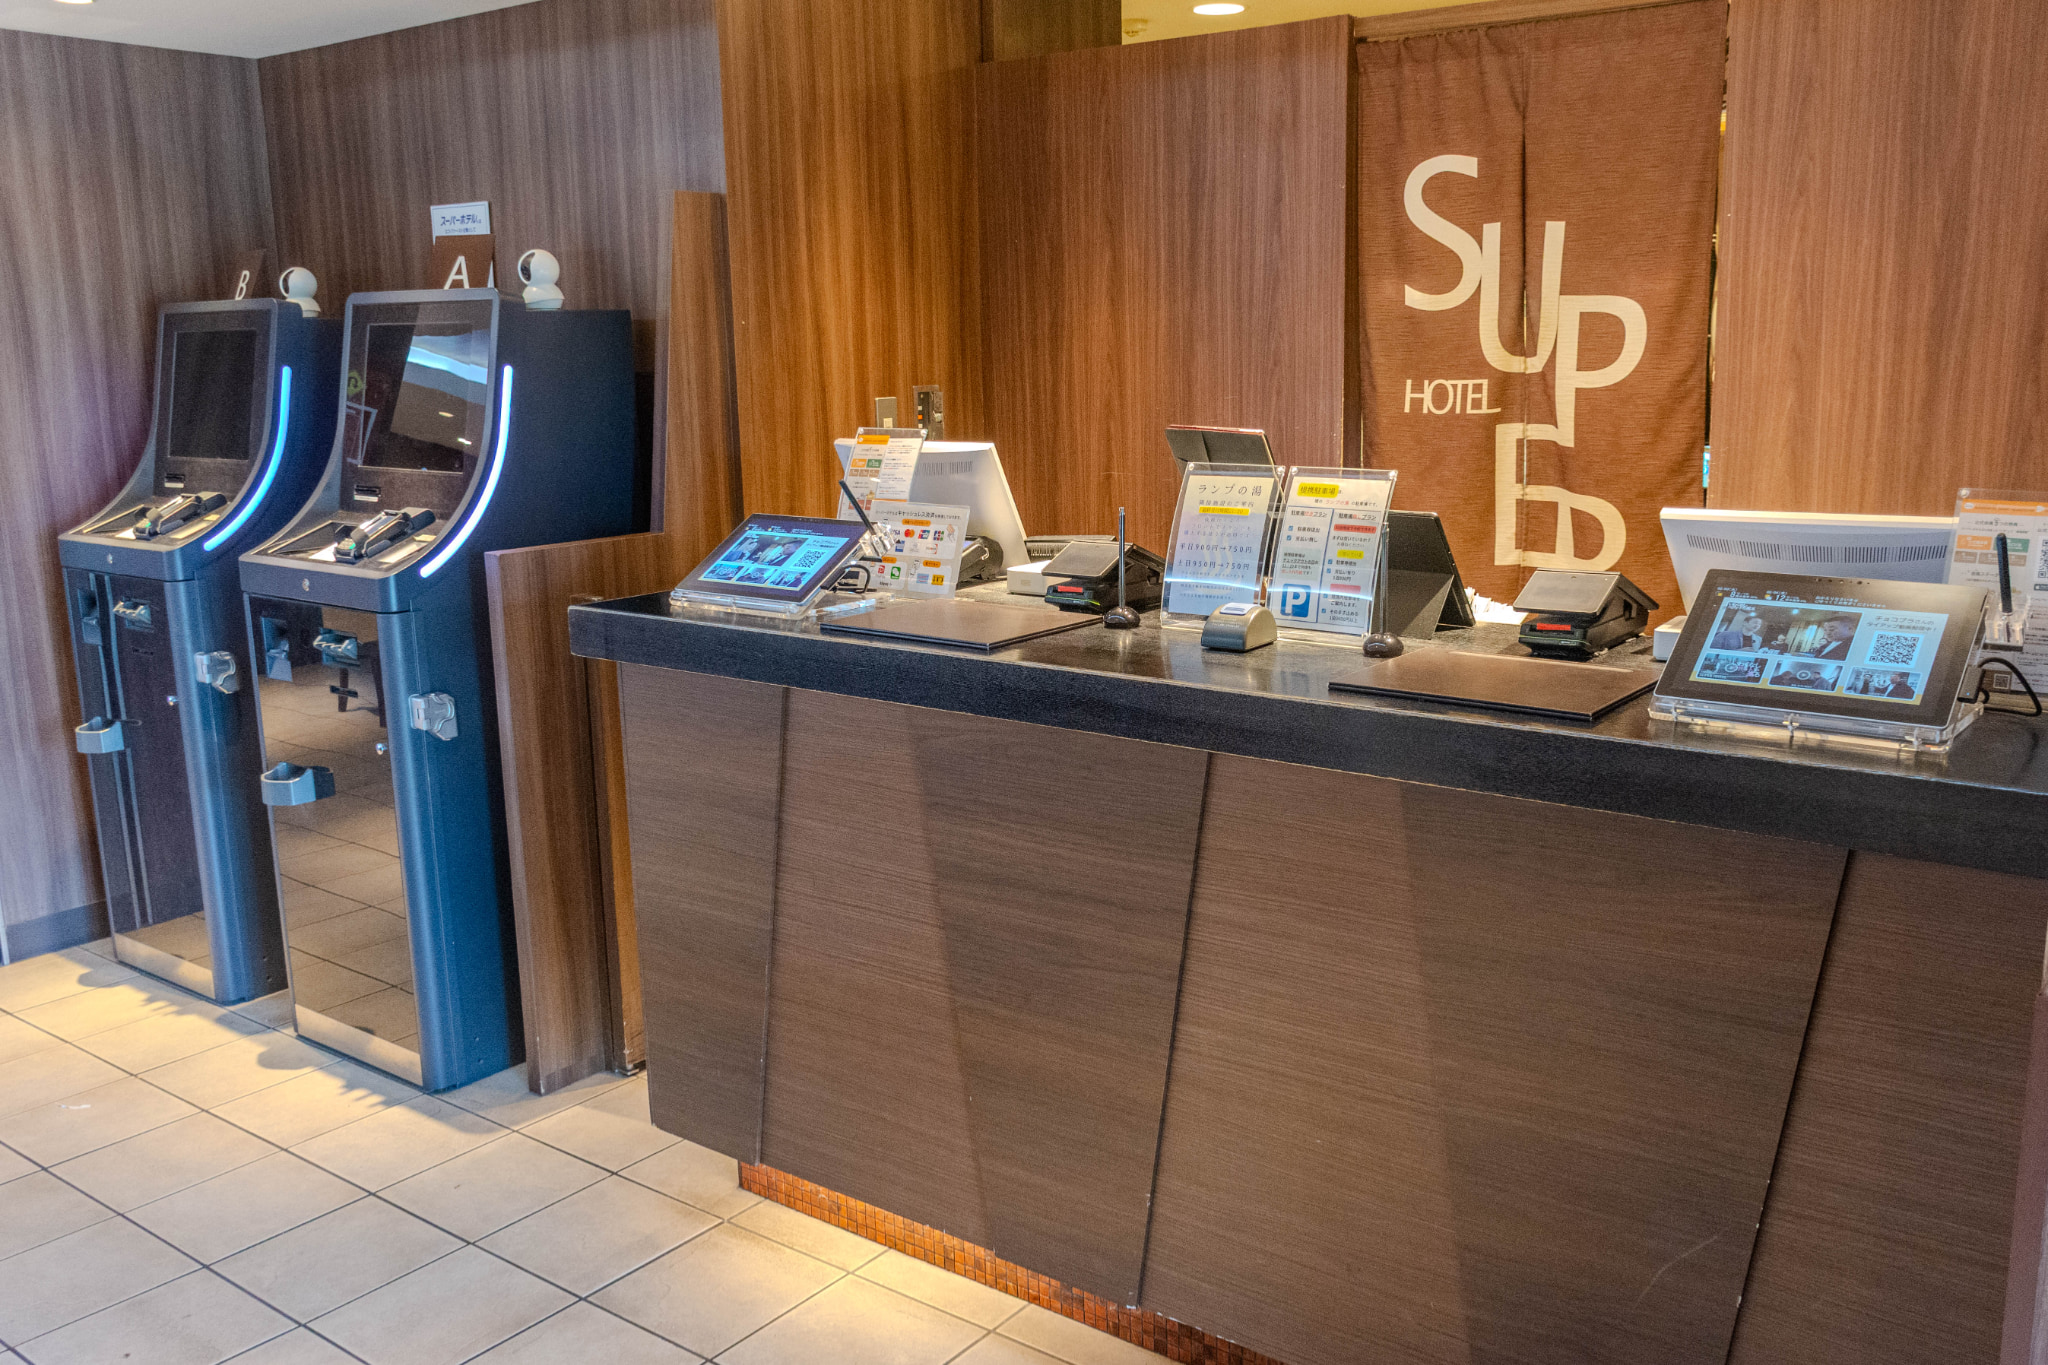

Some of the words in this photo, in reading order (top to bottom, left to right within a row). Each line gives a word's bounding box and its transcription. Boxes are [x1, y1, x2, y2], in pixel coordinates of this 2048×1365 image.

[235, 270, 250, 300] B
[443, 255, 470, 290] A
[1404, 379, 1501, 415] HOTEL
[1198, 484, 1262, 497] ランプの湯
